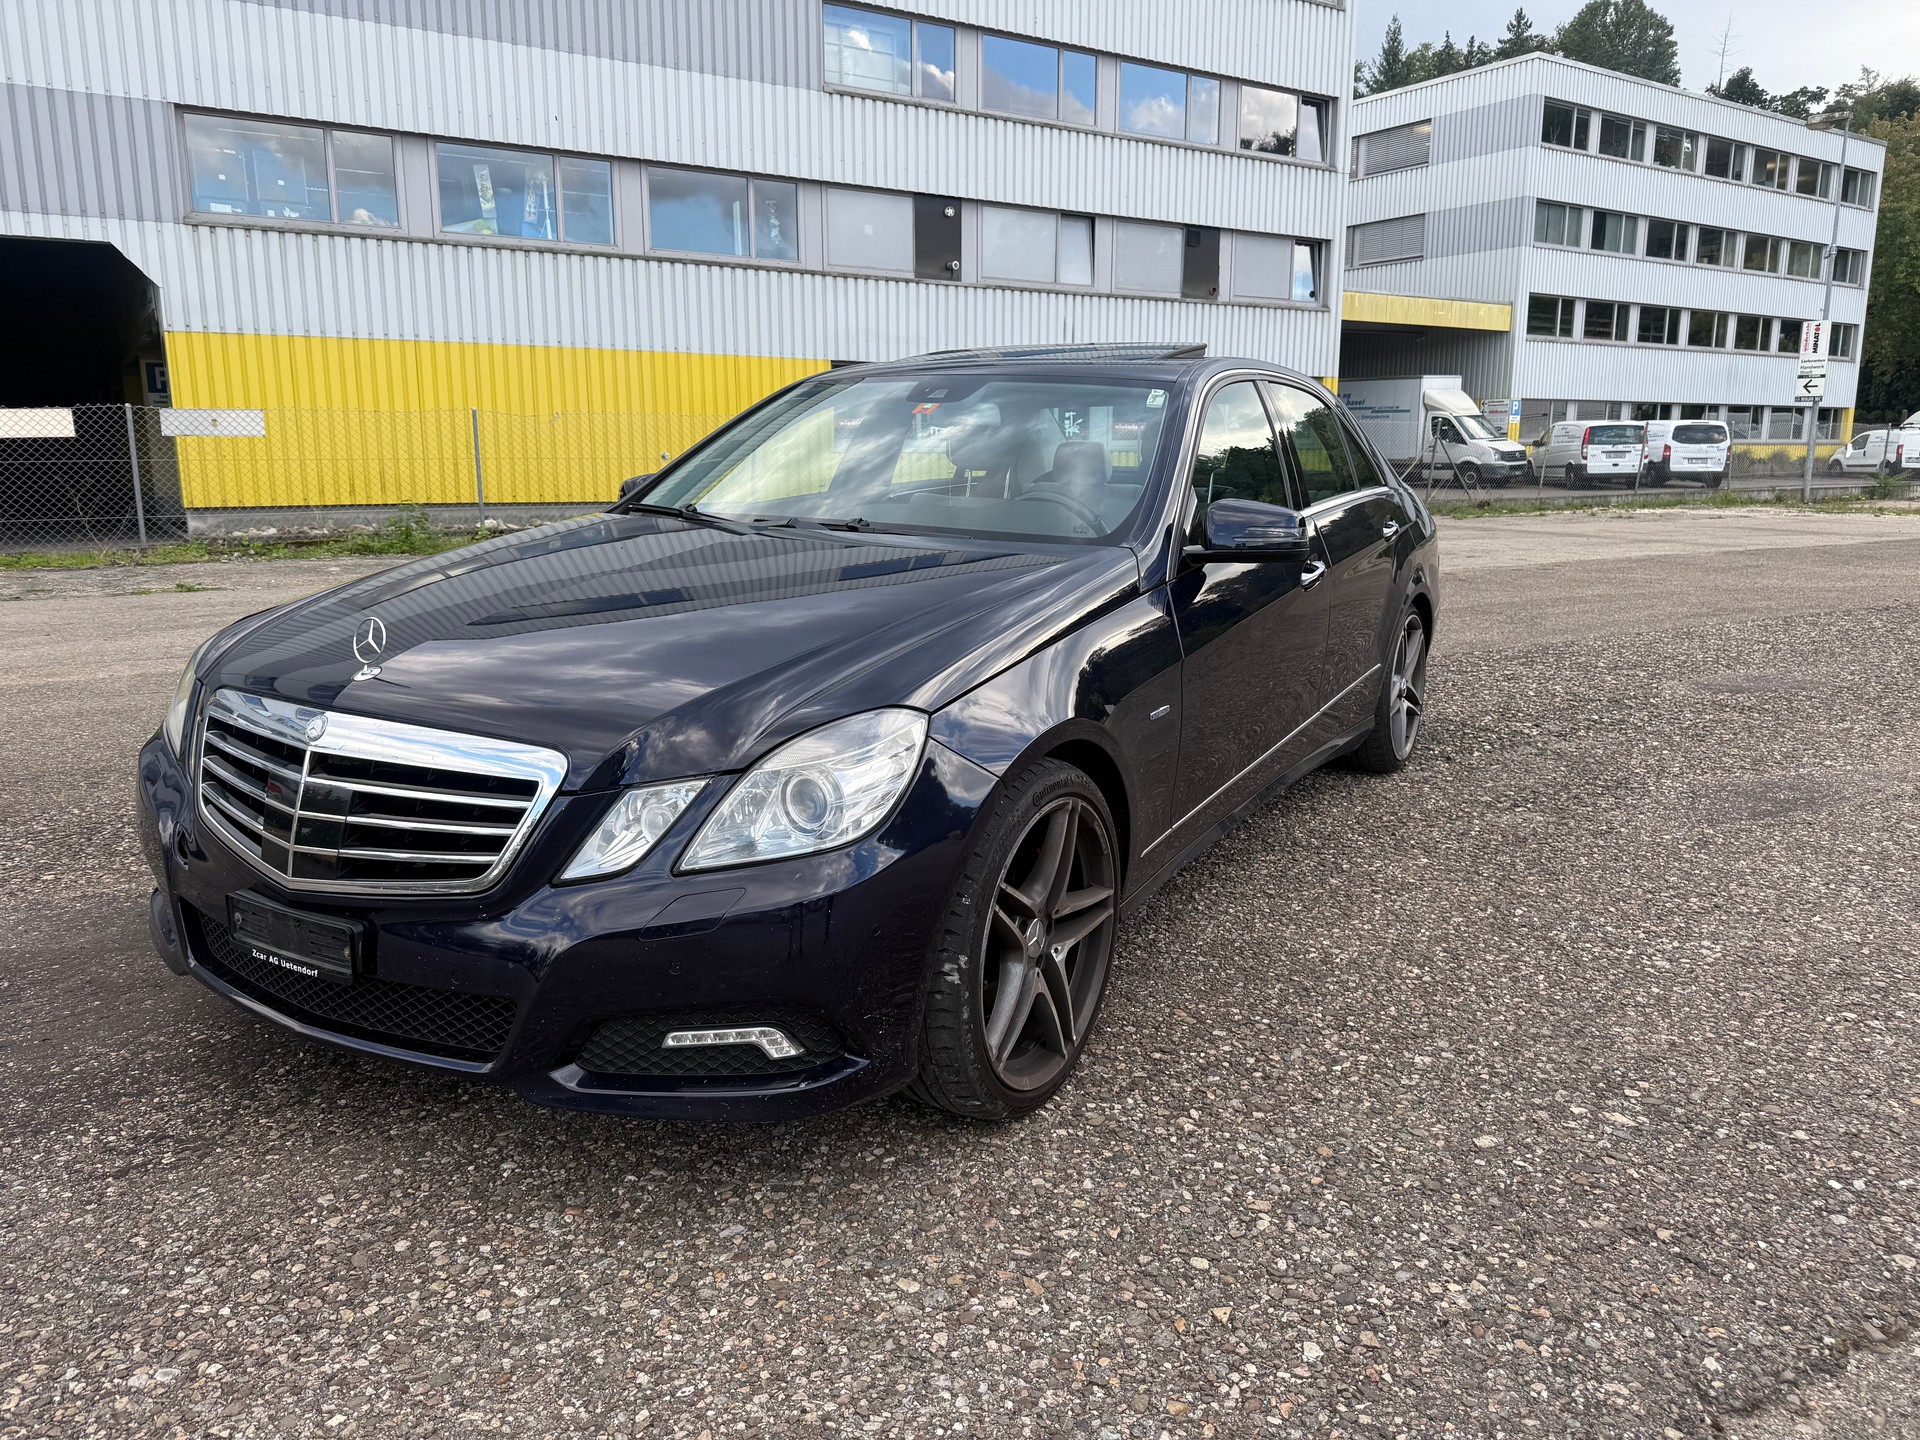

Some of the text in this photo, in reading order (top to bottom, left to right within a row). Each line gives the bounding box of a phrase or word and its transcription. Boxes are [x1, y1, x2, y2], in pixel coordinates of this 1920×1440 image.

[1512, 401, 1519, 415] P
[1033, 776, 1070, 807] Continental
[252, 948, 318, 978] Zcar AG Uetendorf
